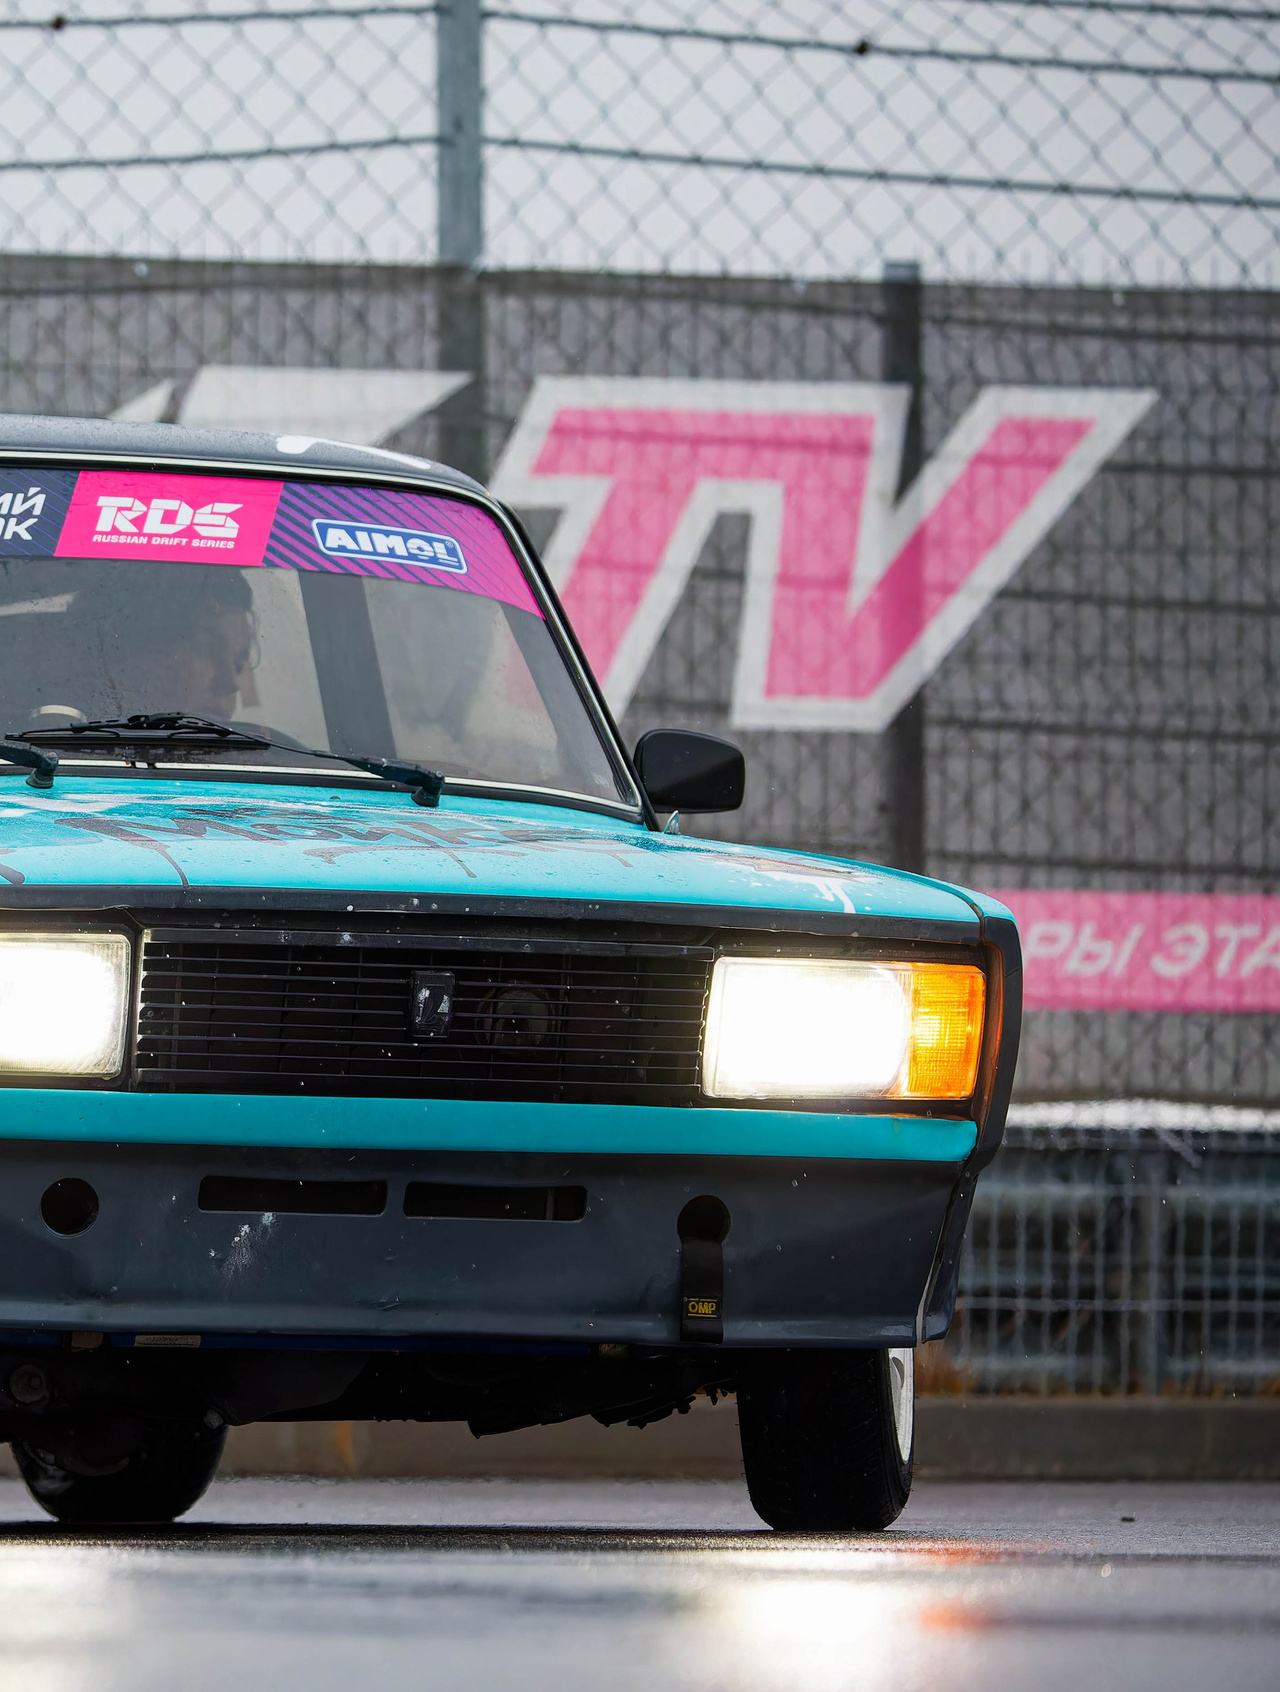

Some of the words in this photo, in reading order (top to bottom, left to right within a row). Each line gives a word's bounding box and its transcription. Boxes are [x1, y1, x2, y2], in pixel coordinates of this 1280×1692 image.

[95, 495, 244, 538] RDS
[92, 533, 148, 545] RUSSIAN
[150, 535, 189, 547] DRIFT
[191, 538, 236, 550] SERIES
[325, 527, 458, 568] AIMOL
[688, 1301, 717, 1314] OMP
